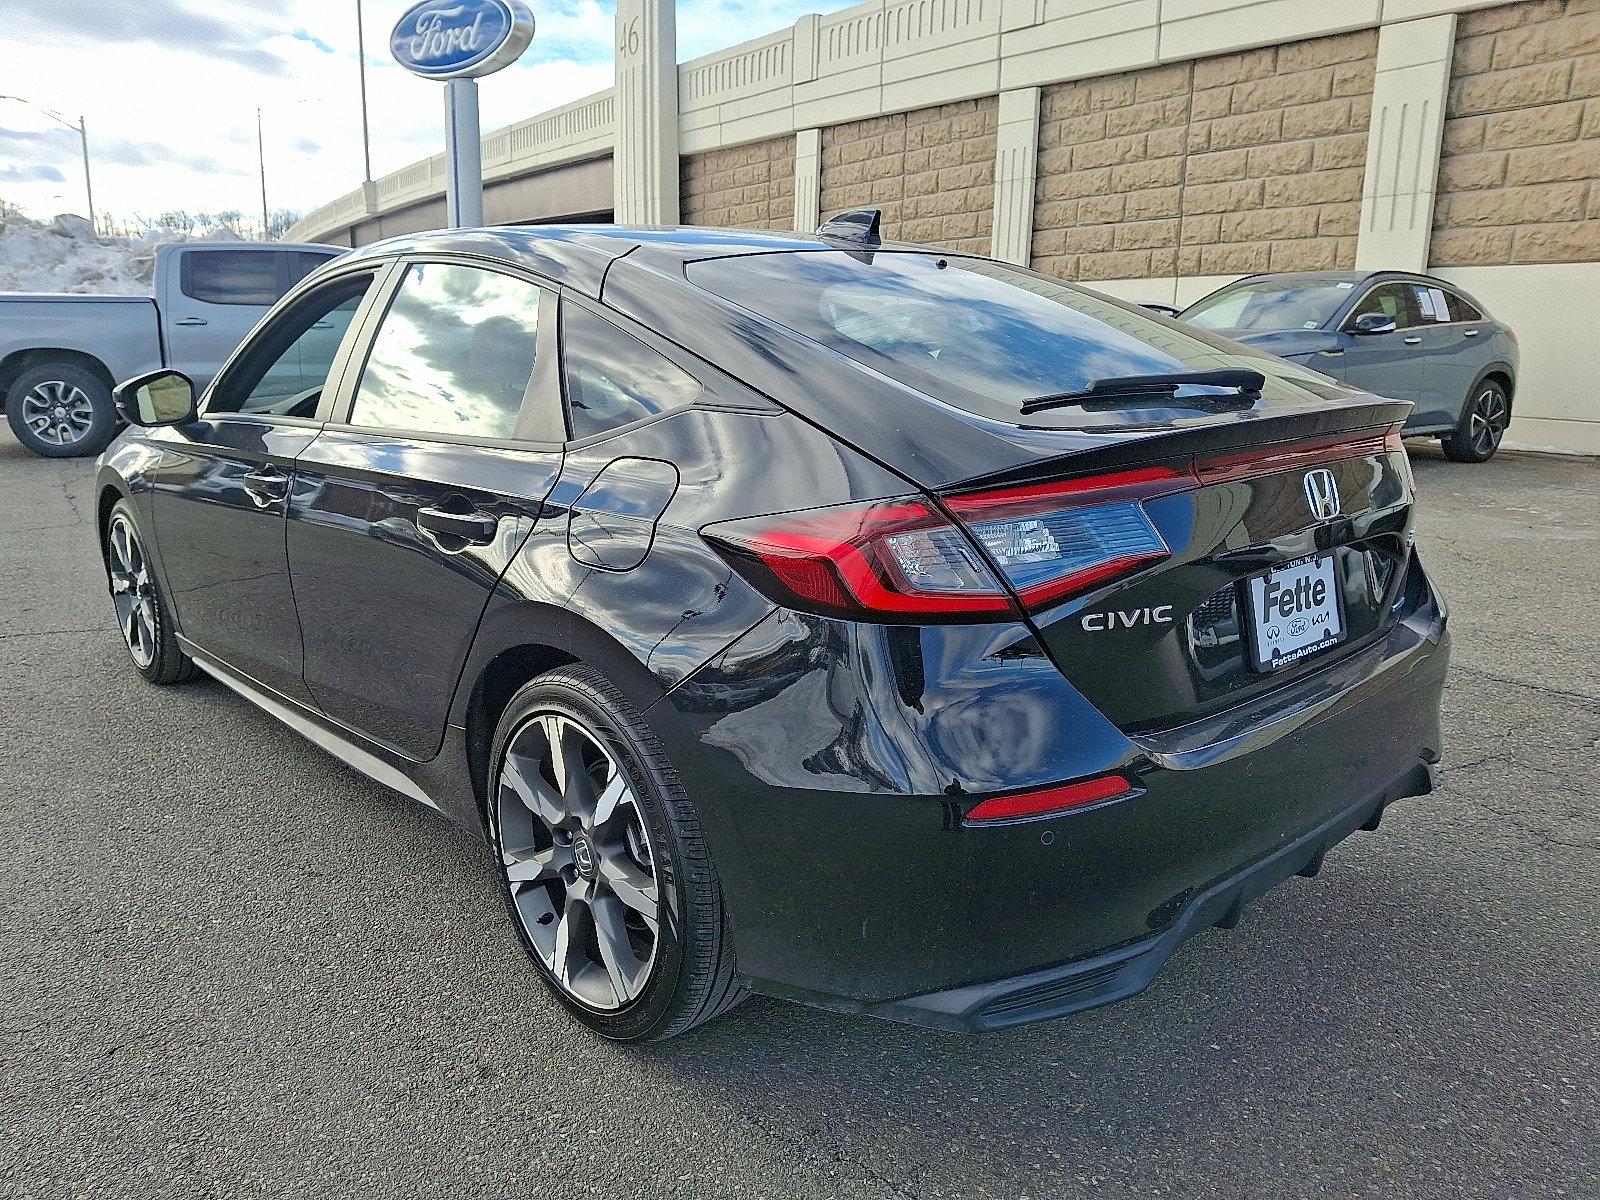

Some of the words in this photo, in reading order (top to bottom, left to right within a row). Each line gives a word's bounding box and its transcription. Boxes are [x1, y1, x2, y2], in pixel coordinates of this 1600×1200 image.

[410, 4, 484, 62] Ford
[1263, 575, 1326, 624] Fette
[1081, 605, 1173, 631] CIVIC
[1289, 617, 1307, 635] Ford
[1272, 638, 1338, 668] FetteAuto.com
